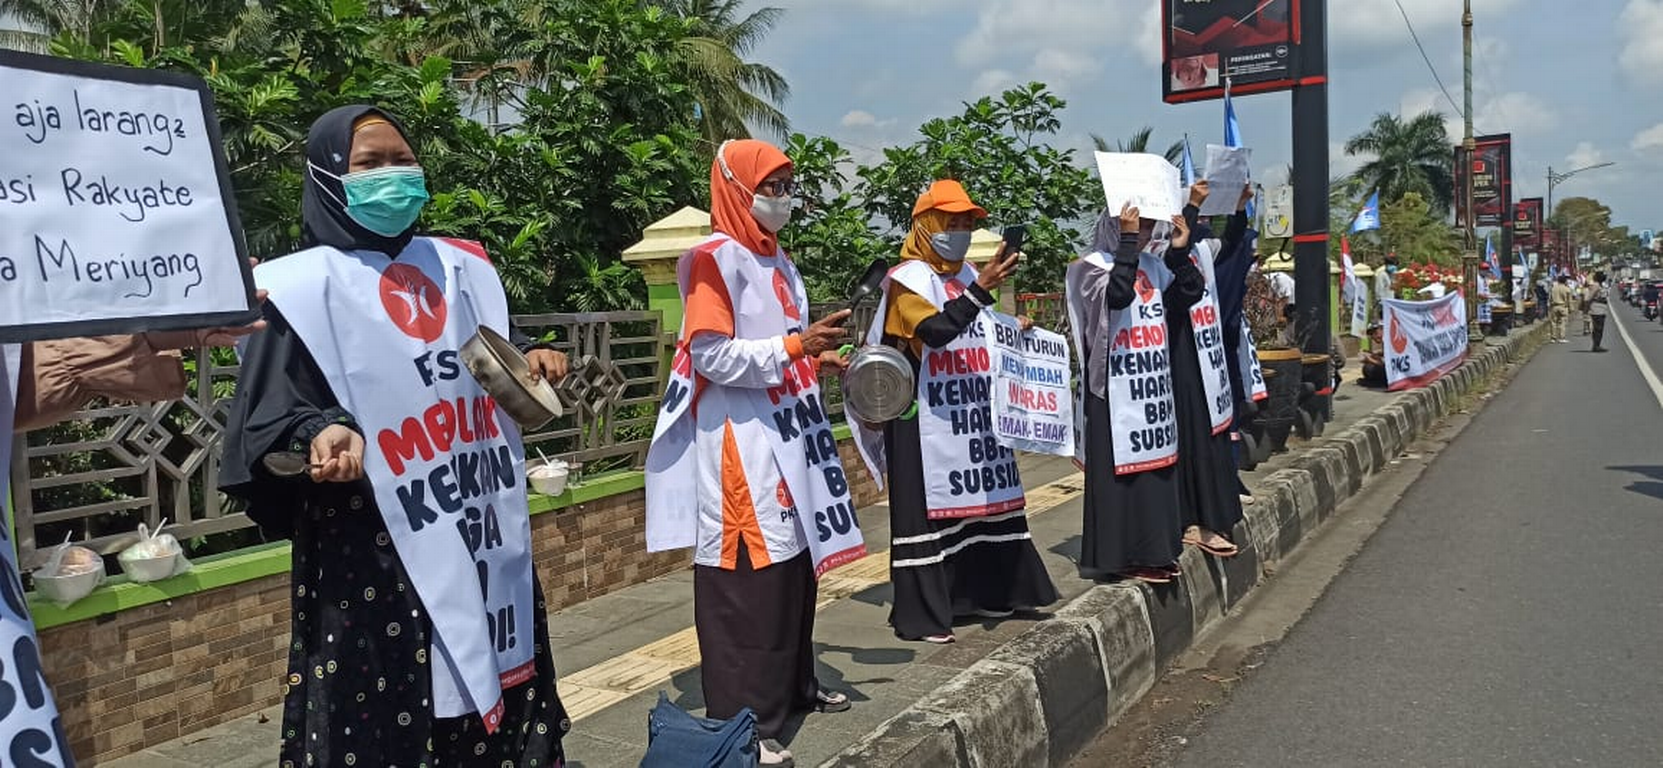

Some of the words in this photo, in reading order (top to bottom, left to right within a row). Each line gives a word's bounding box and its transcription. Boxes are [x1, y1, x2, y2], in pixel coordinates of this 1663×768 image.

[15, 99, 62, 144] aja
[60, 167, 193, 222] Rakyate
[34, 233, 203, 298] Meriyang
[1023, 337, 1065, 358] TURUN
